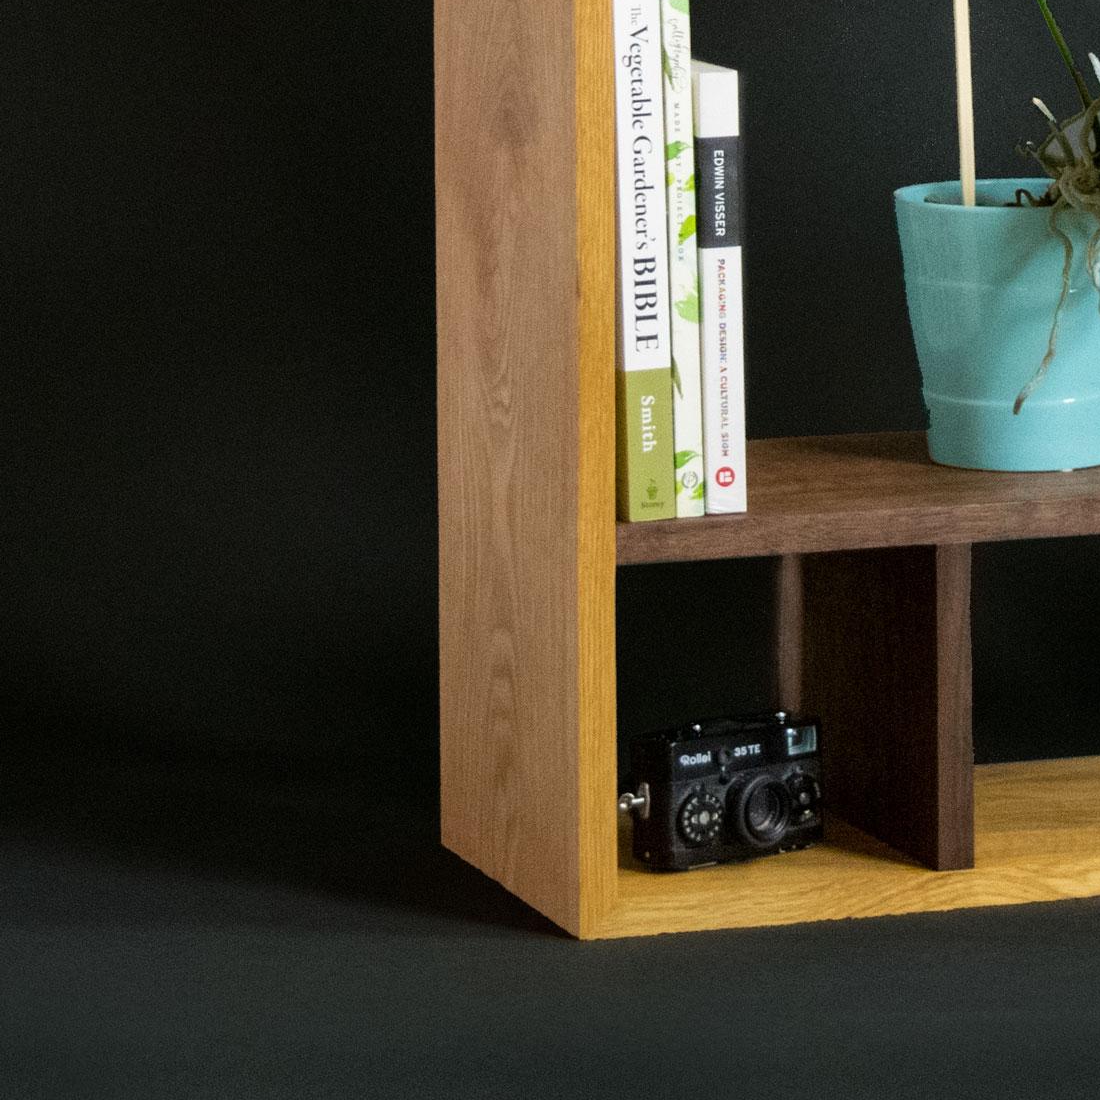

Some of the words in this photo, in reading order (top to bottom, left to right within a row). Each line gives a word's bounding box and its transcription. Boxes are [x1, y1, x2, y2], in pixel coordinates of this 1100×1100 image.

[630, 4, 641, 26] The
[622, 25, 652, 130] Vegetable
[633, 135, 655, 251] Gardener's
[714, 149, 725, 189] EDWIN
[715, 193, 726, 237] VISSER
[633, 256, 659, 353] BIBLE
[717, 258, 726, 319] PACKAGING
[720, 365, 728, 374] A
[641, 395, 657, 452] Smith
[720, 376, 729, 430] CULTURAL
[721, 433, 730, 458] SIGN
[680, 750, 712, 766] Rollei
